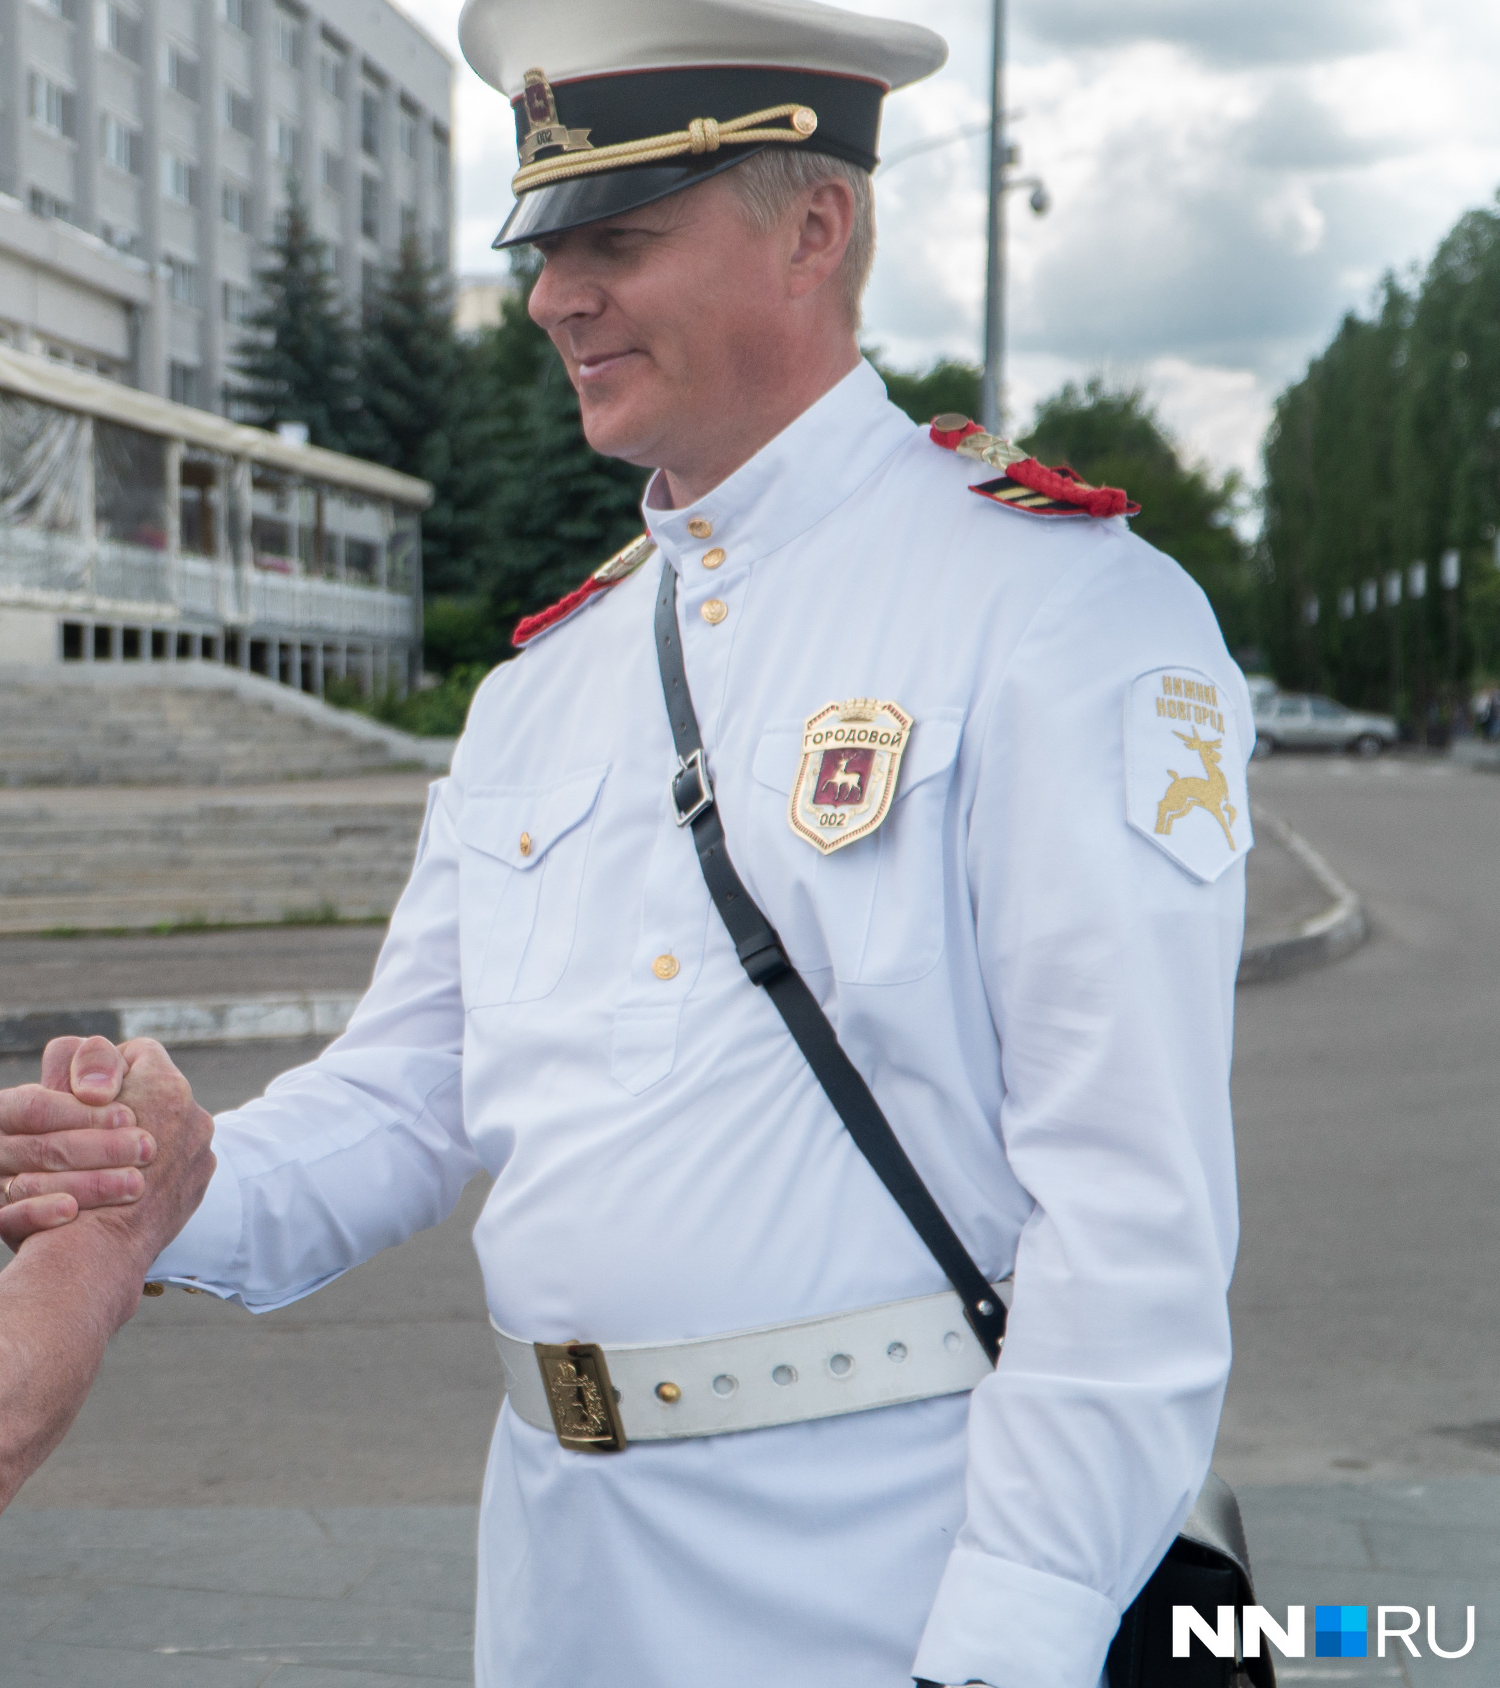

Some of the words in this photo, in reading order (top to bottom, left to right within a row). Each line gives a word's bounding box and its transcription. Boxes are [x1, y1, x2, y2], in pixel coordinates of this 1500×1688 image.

[537, 129, 553, 145] 002
[1162, 675, 1218, 708] НИЖНИЙ
[1156, 697, 1225, 735] НОВГОРОД
[804, 728, 903, 748] ГОРОДОВОЙ
[819, 813, 846, 826] 002
